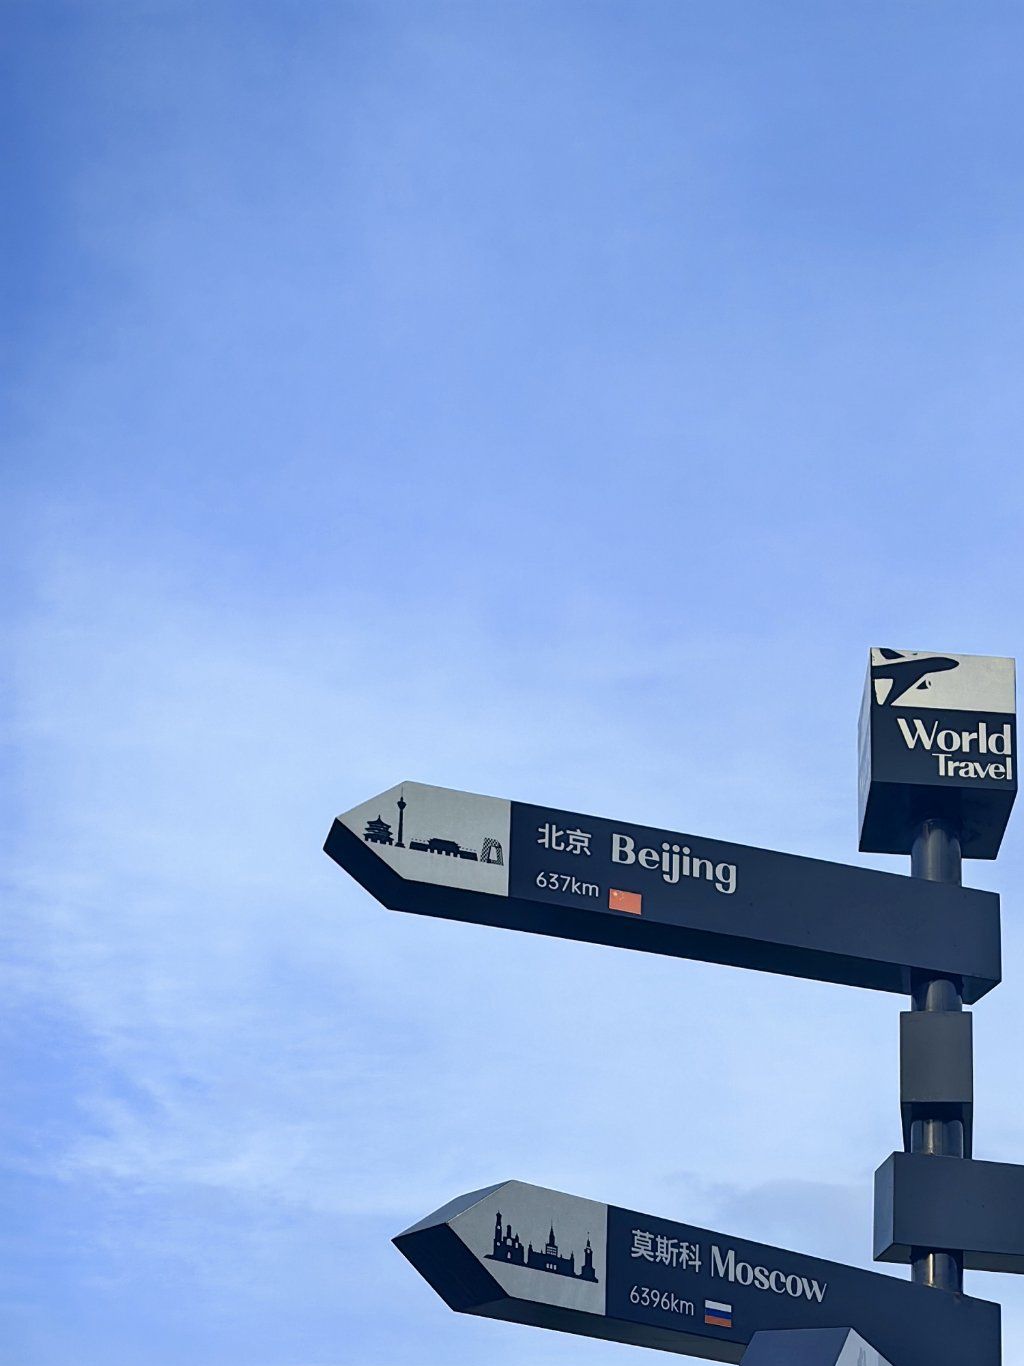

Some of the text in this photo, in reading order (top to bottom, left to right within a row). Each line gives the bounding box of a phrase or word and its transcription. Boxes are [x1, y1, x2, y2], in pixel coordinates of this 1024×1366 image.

[897, 718, 1012, 755] World
[932, 753, 1013, 780] Travel
[537, 823, 737, 894] 北京 Beijing
[536, 872, 599, 897] 637km
[631, 1229, 827, 1303] 莫斯科 Moscow
[630, 1285, 694, 1316] 6396km
